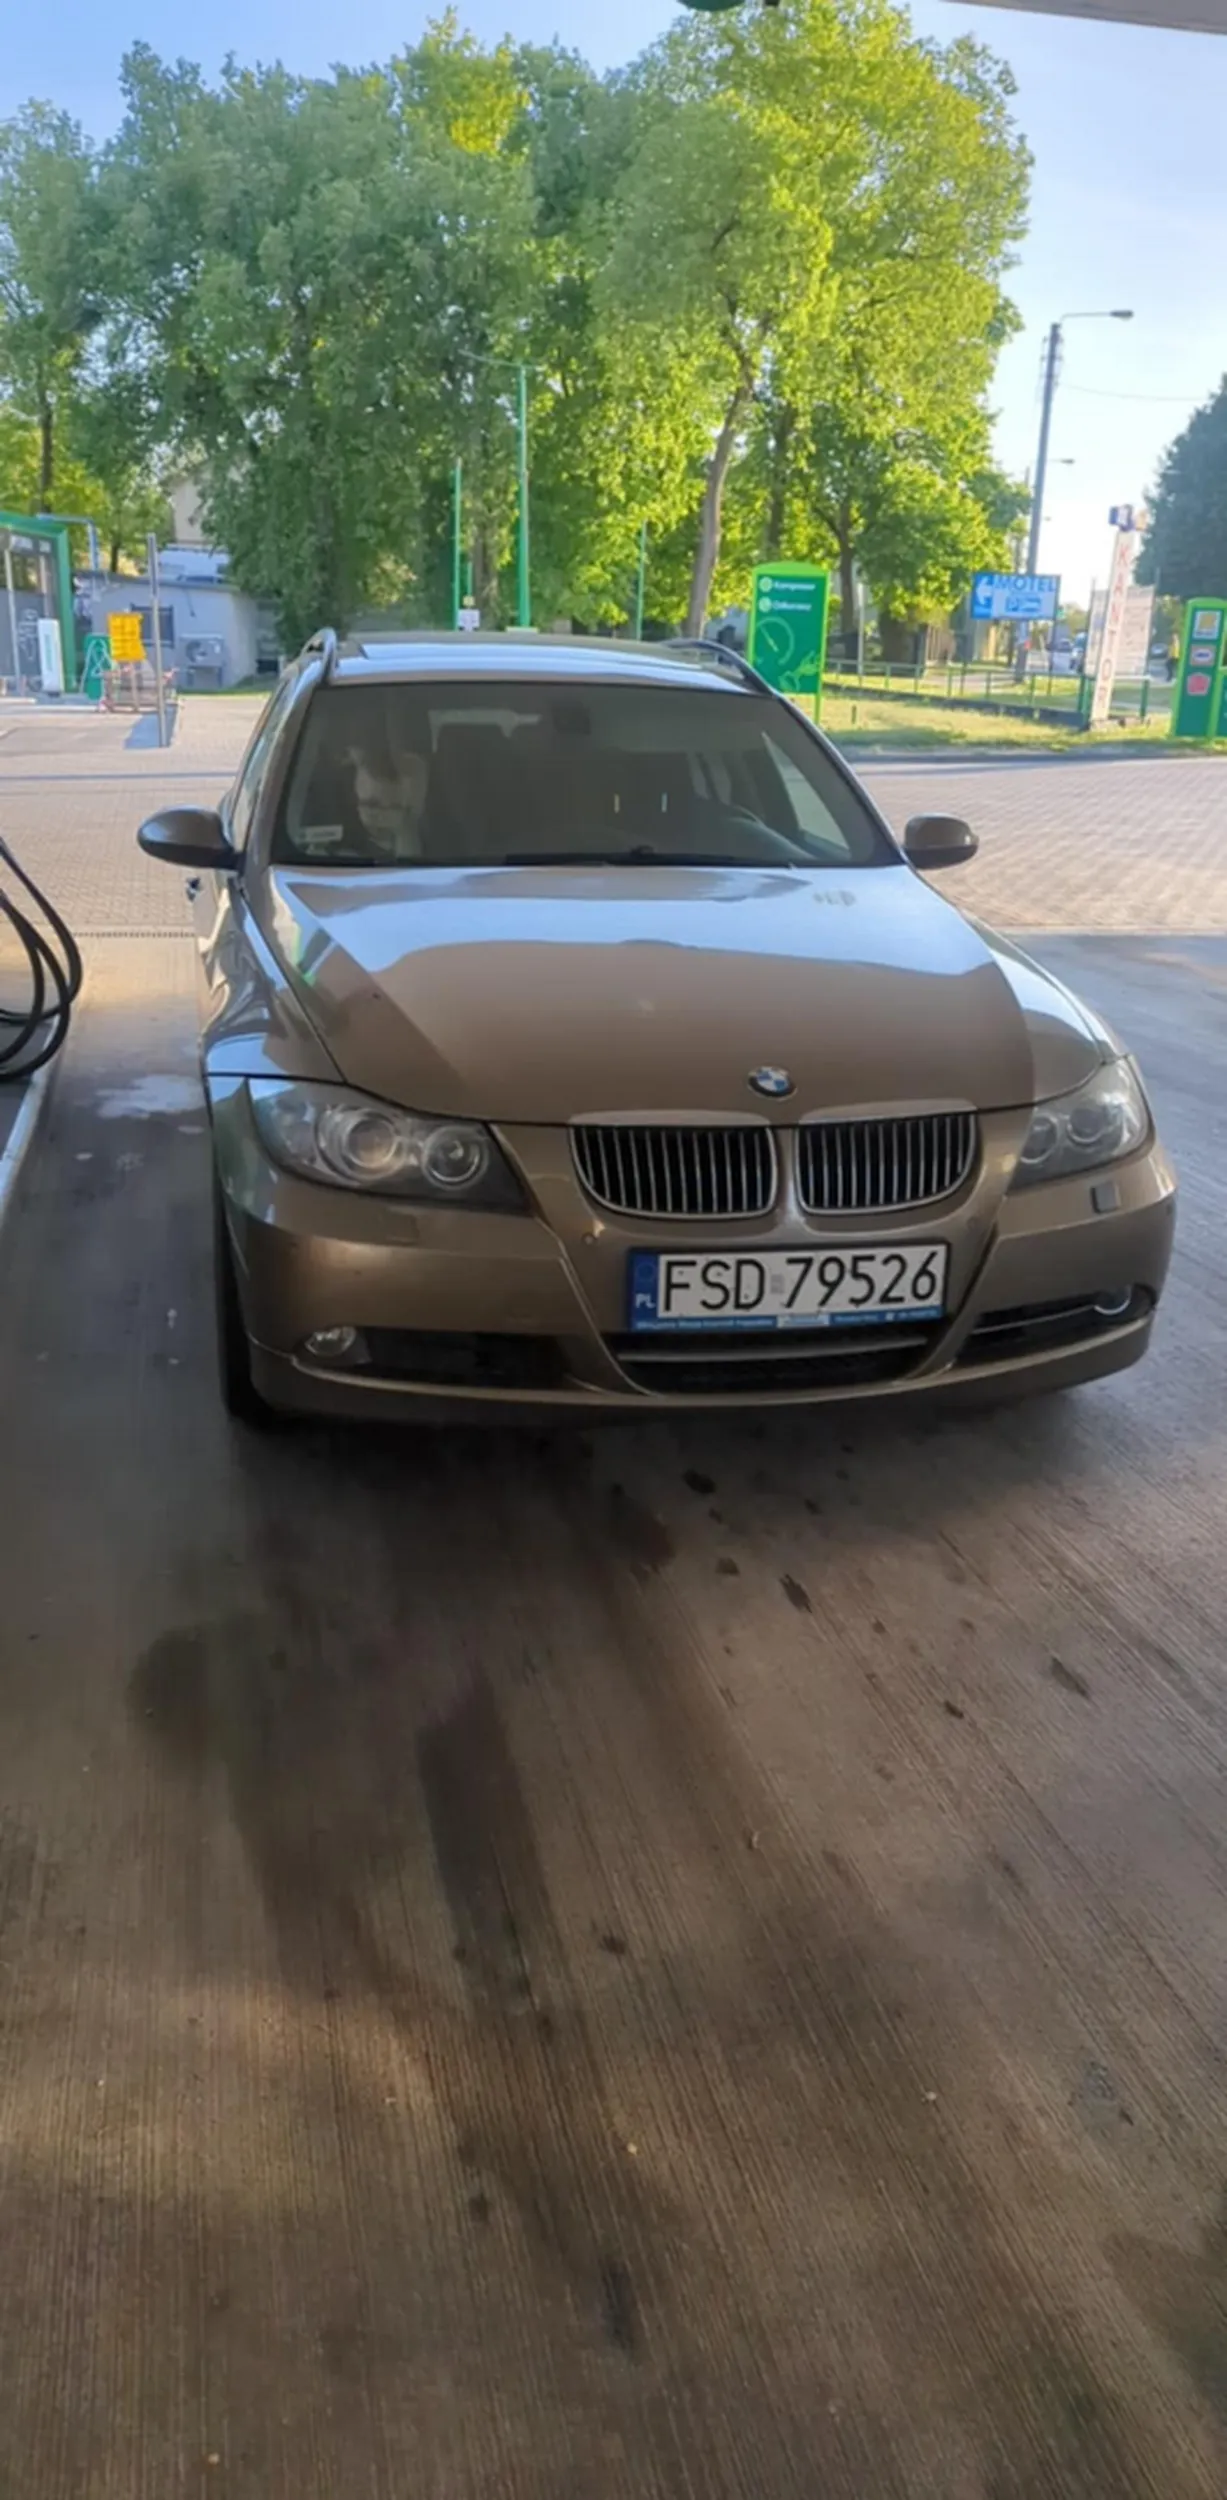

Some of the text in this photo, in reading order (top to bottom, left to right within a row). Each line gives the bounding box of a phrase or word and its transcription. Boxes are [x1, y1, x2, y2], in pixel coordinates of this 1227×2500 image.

[994, 575, 1056, 592] MOTEL
[664, 1251, 937, 1312] FSD 79526
[635, 1293, 656, 1308] PL
